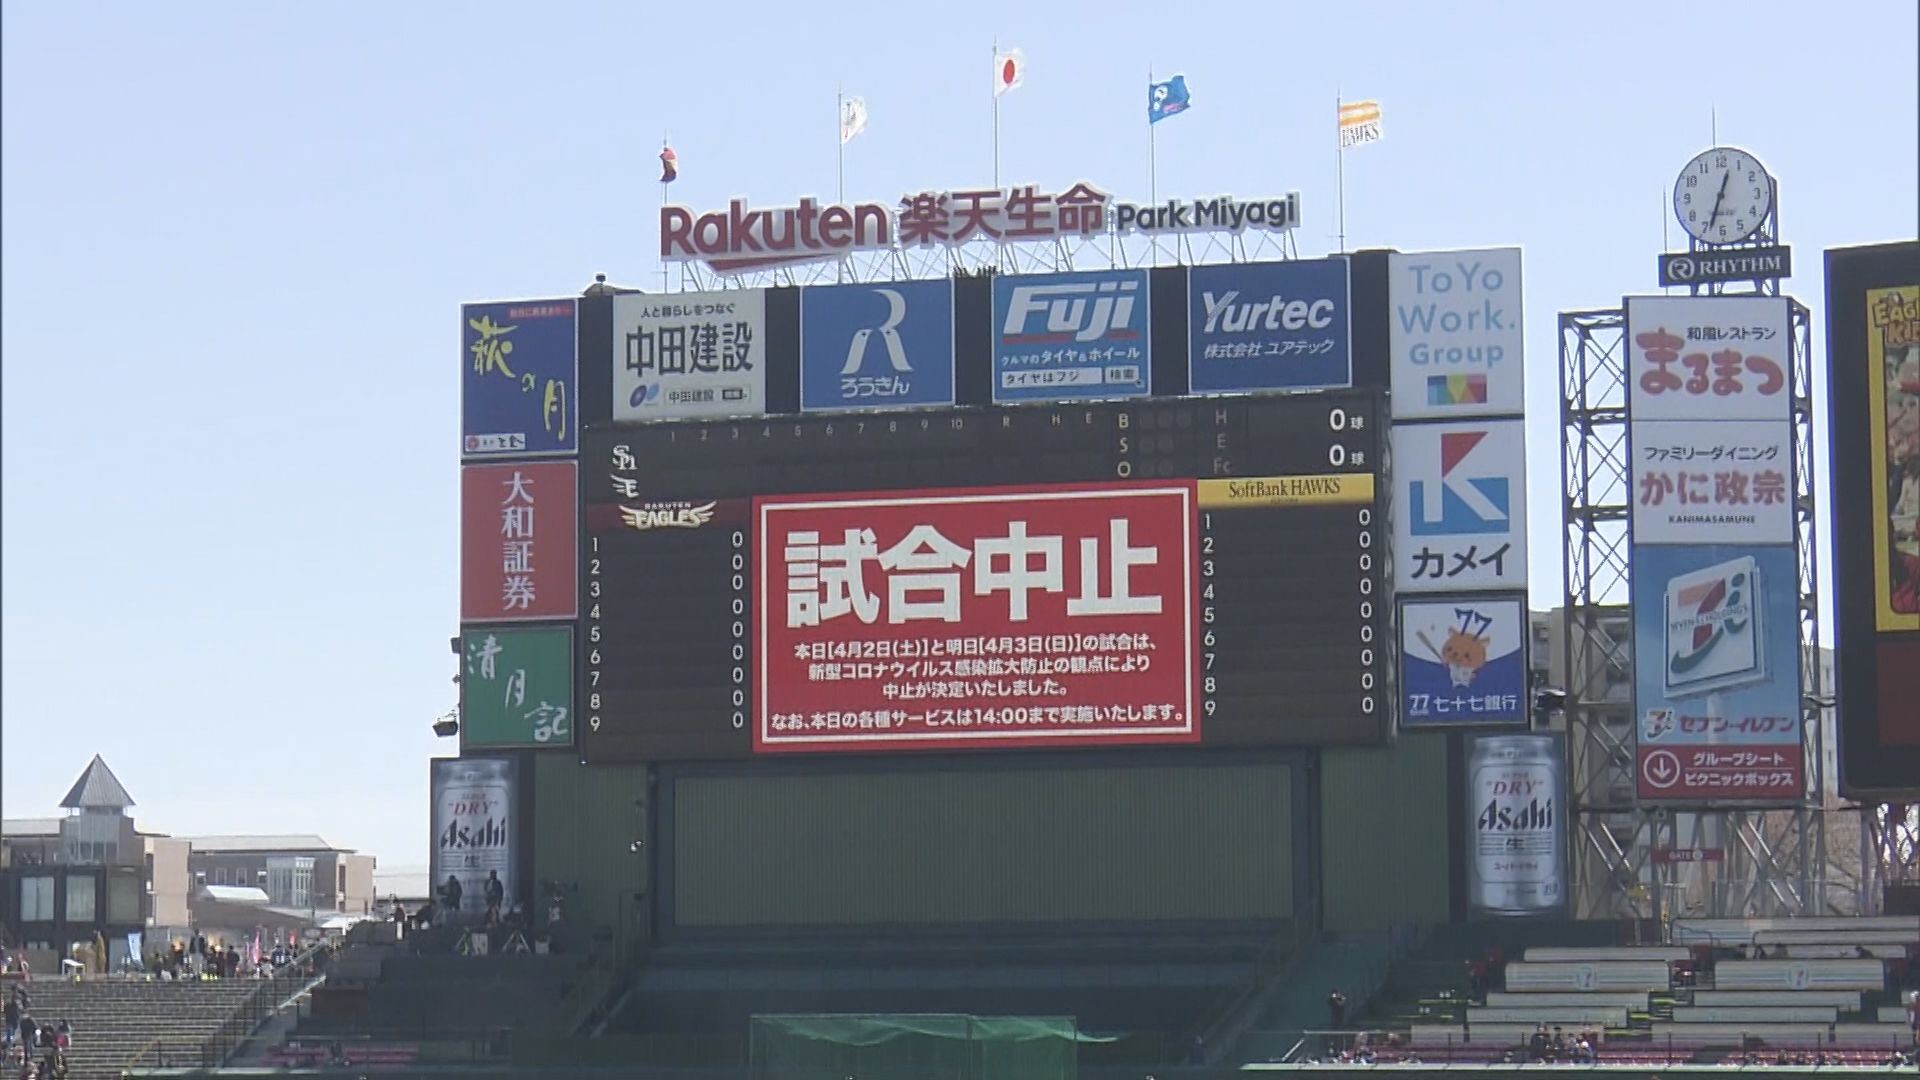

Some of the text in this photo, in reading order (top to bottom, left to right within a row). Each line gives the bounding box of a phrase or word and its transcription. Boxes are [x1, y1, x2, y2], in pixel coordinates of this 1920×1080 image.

[1700, 162, 1708, 174] 11
[1716, 156, 1727, 168] 12
[1737, 160, 1740, 171] 1
[1686, 176, 1697, 187] 10
[1748, 171, 1756, 182] 2
[1684, 193, 1691, 204] 9
[1754, 188, 1760, 200] 3
[661, 183, 1295, 256] Rakuten 楽天生命 Park Miyagi
[1689, 210, 1696, 222] 8
[1749, 206, 1756, 217] 4
[1702, 222, 1709, 233] 7
[1720, 226, 1726, 236] 6
[1737, 220, 1744, 230] 5
[1700, 256, 1781, 274] RHYTHM
[641, 303, 735, 318] 人と暮らしをつなぐ
[1003, 281, 1138, 342] Fuji
[1203, 290, 1334, 333] Yurtec
[1398, 299, 1516, 334] Work.
[1687, 326, 1777, 341] 和風レストラン
[626, 322, 753, 378] 中田建設
[1204, 339, 1335, 359] 株式会社 ユアテック
[1409, 343, 1504, 369] Group
[1636, 327, 1784, 396] まるまつ
[841, 376, 910, 398] ろうきん
[1006, 370, 1080, 384] タイヤはフジ
[1118, 414, 1128, 428] B
[1216, 410, 1227, 425] H
[700, 429, 708, 441] 2
[732, 427, 738, 439] 3
[762, 426, 770, 438] 4
[794, 425, 801, 436] 5
[826, 424, 833, 435] 6
[858, 422, 865, 434] 7
[889, 421, 896, 433] 8
[921, 420, 928, 431] 9
[951, 418, 963, 431] 10
[1120, 438, 1128, 453] S
[1217, 434, 1226, 448] E
[1645, 446, 1778, 461] ファミリーダイニング
[1229, 478, 1341, 499] SoftBank HAWKS
[1640, 470, 1785, 506] かに政宗
[636, 510, 701, 529] EAGLES
[1206, 509, 1370, 529] 1 0
[501, 471, 535, 610] 大和証券
[593, 531, 743, 552] 1 0
[1204, 532, 1370, 553] 2 0
[590, 554, 743, 574] 2 0
[1204, 554, 1371, 576] 3 0
[1411, 543, 1511, 579] カメイ
[785, 517, 1162, 628] 試合中止
[590, 574, 743, 597] 3 0
[1204, 578, 1371, 600] 4 0
[590, 599, 743, 619] 4 0
[1204, 602, 1372, 623] 5 0
[590, 621, 743, 642] 5 0
[1454, 607, 1493, 640] 77
[1204, 626, 1372, 646] 6 0
[590, 644, 743, 664] 6 0
[1205, 649, 1372, 670] 7 0
[590, 667, 743, 686] 7 0
[808, 655, 1150, 681] 新型コロナウイルス感染拡大防止の観点により
[467, 634, 567, 742] 清月記
[883, 680, 1067, 699] 中止が決定いたしました。
[1205, 673, 1373, 693] 8 0
[590, 689, 743, 709] 8 0
[1205, 697, 1373, 715] 9 0
[1409, 694, 1517, 712] 77 七十七銀行
[590, 712, 743, 731] 9 0
[1694, 753, 1784, 767] グループシート
[1478, 798, 1552, 832] Asahi
[440, 816, 506, 848] Asahi
